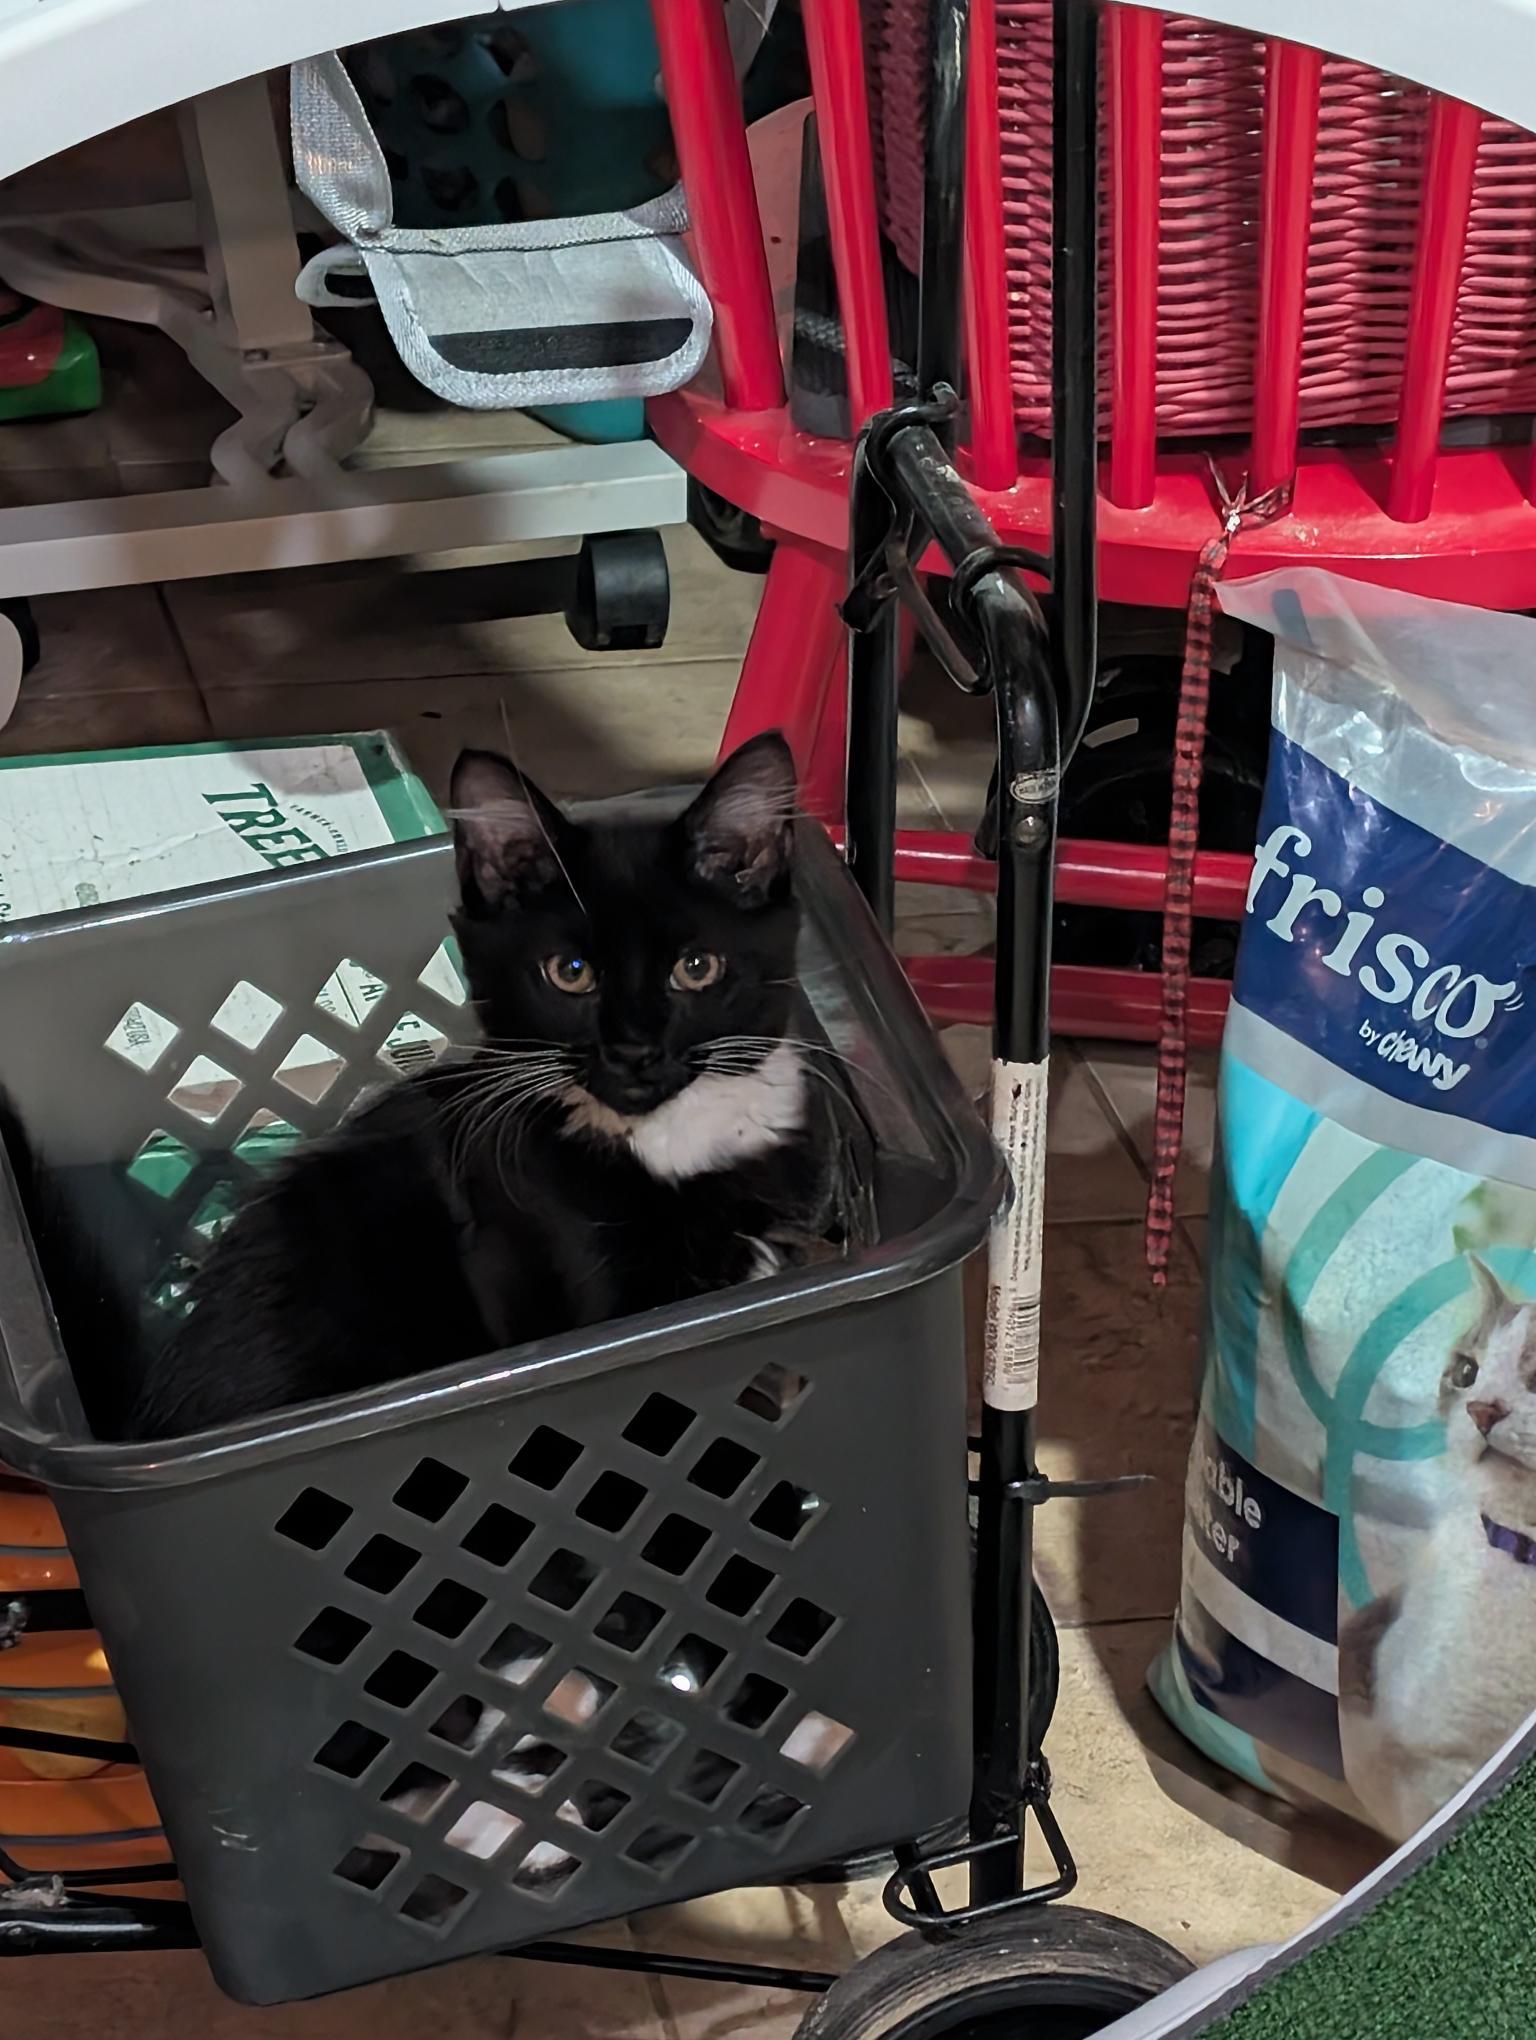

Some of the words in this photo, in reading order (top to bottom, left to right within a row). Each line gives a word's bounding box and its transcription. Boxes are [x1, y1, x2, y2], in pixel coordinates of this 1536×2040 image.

[201, 783, 329, 868] TREE
[1246, 825, 1517, 1039] frisco
[1359, 1018, 1382, 1046] by
[1377, 1029, 1471, 1091] chewy
